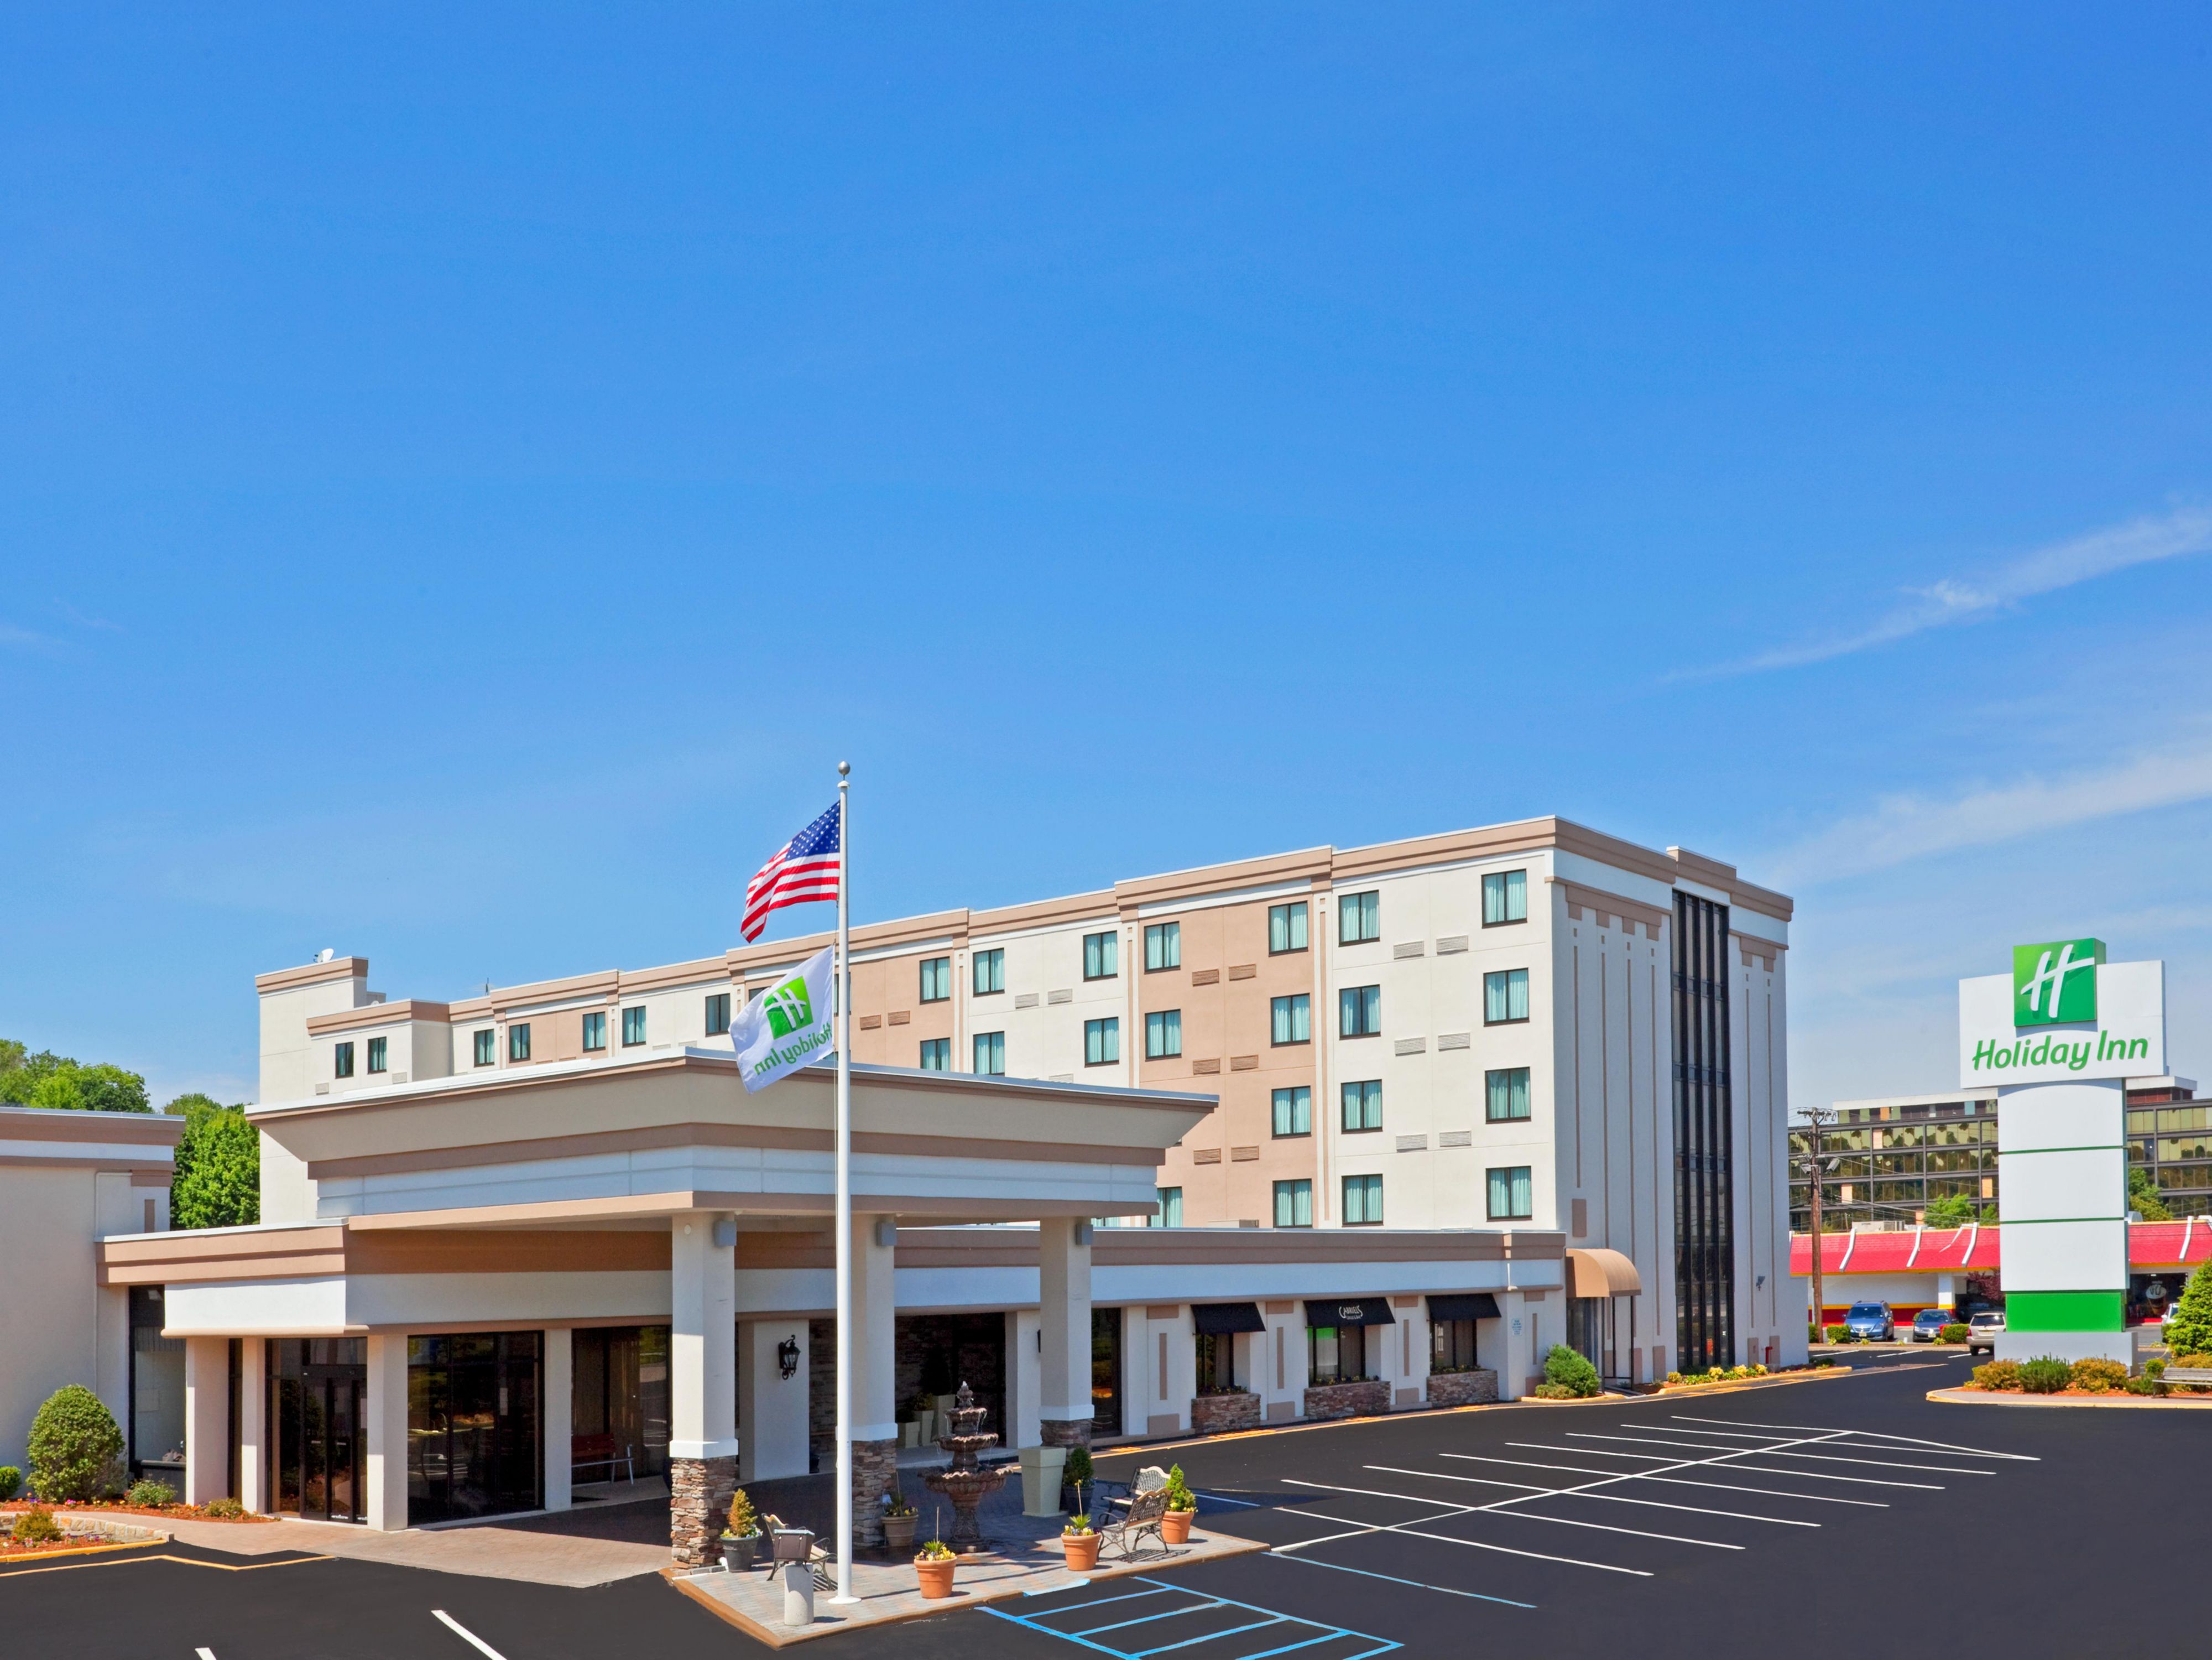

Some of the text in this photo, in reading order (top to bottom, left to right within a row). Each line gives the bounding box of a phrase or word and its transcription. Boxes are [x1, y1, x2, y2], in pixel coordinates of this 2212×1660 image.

[2020, 944, 2095, 1018] H
[1972, 1030, 2148, 1071] Holiday Inn
